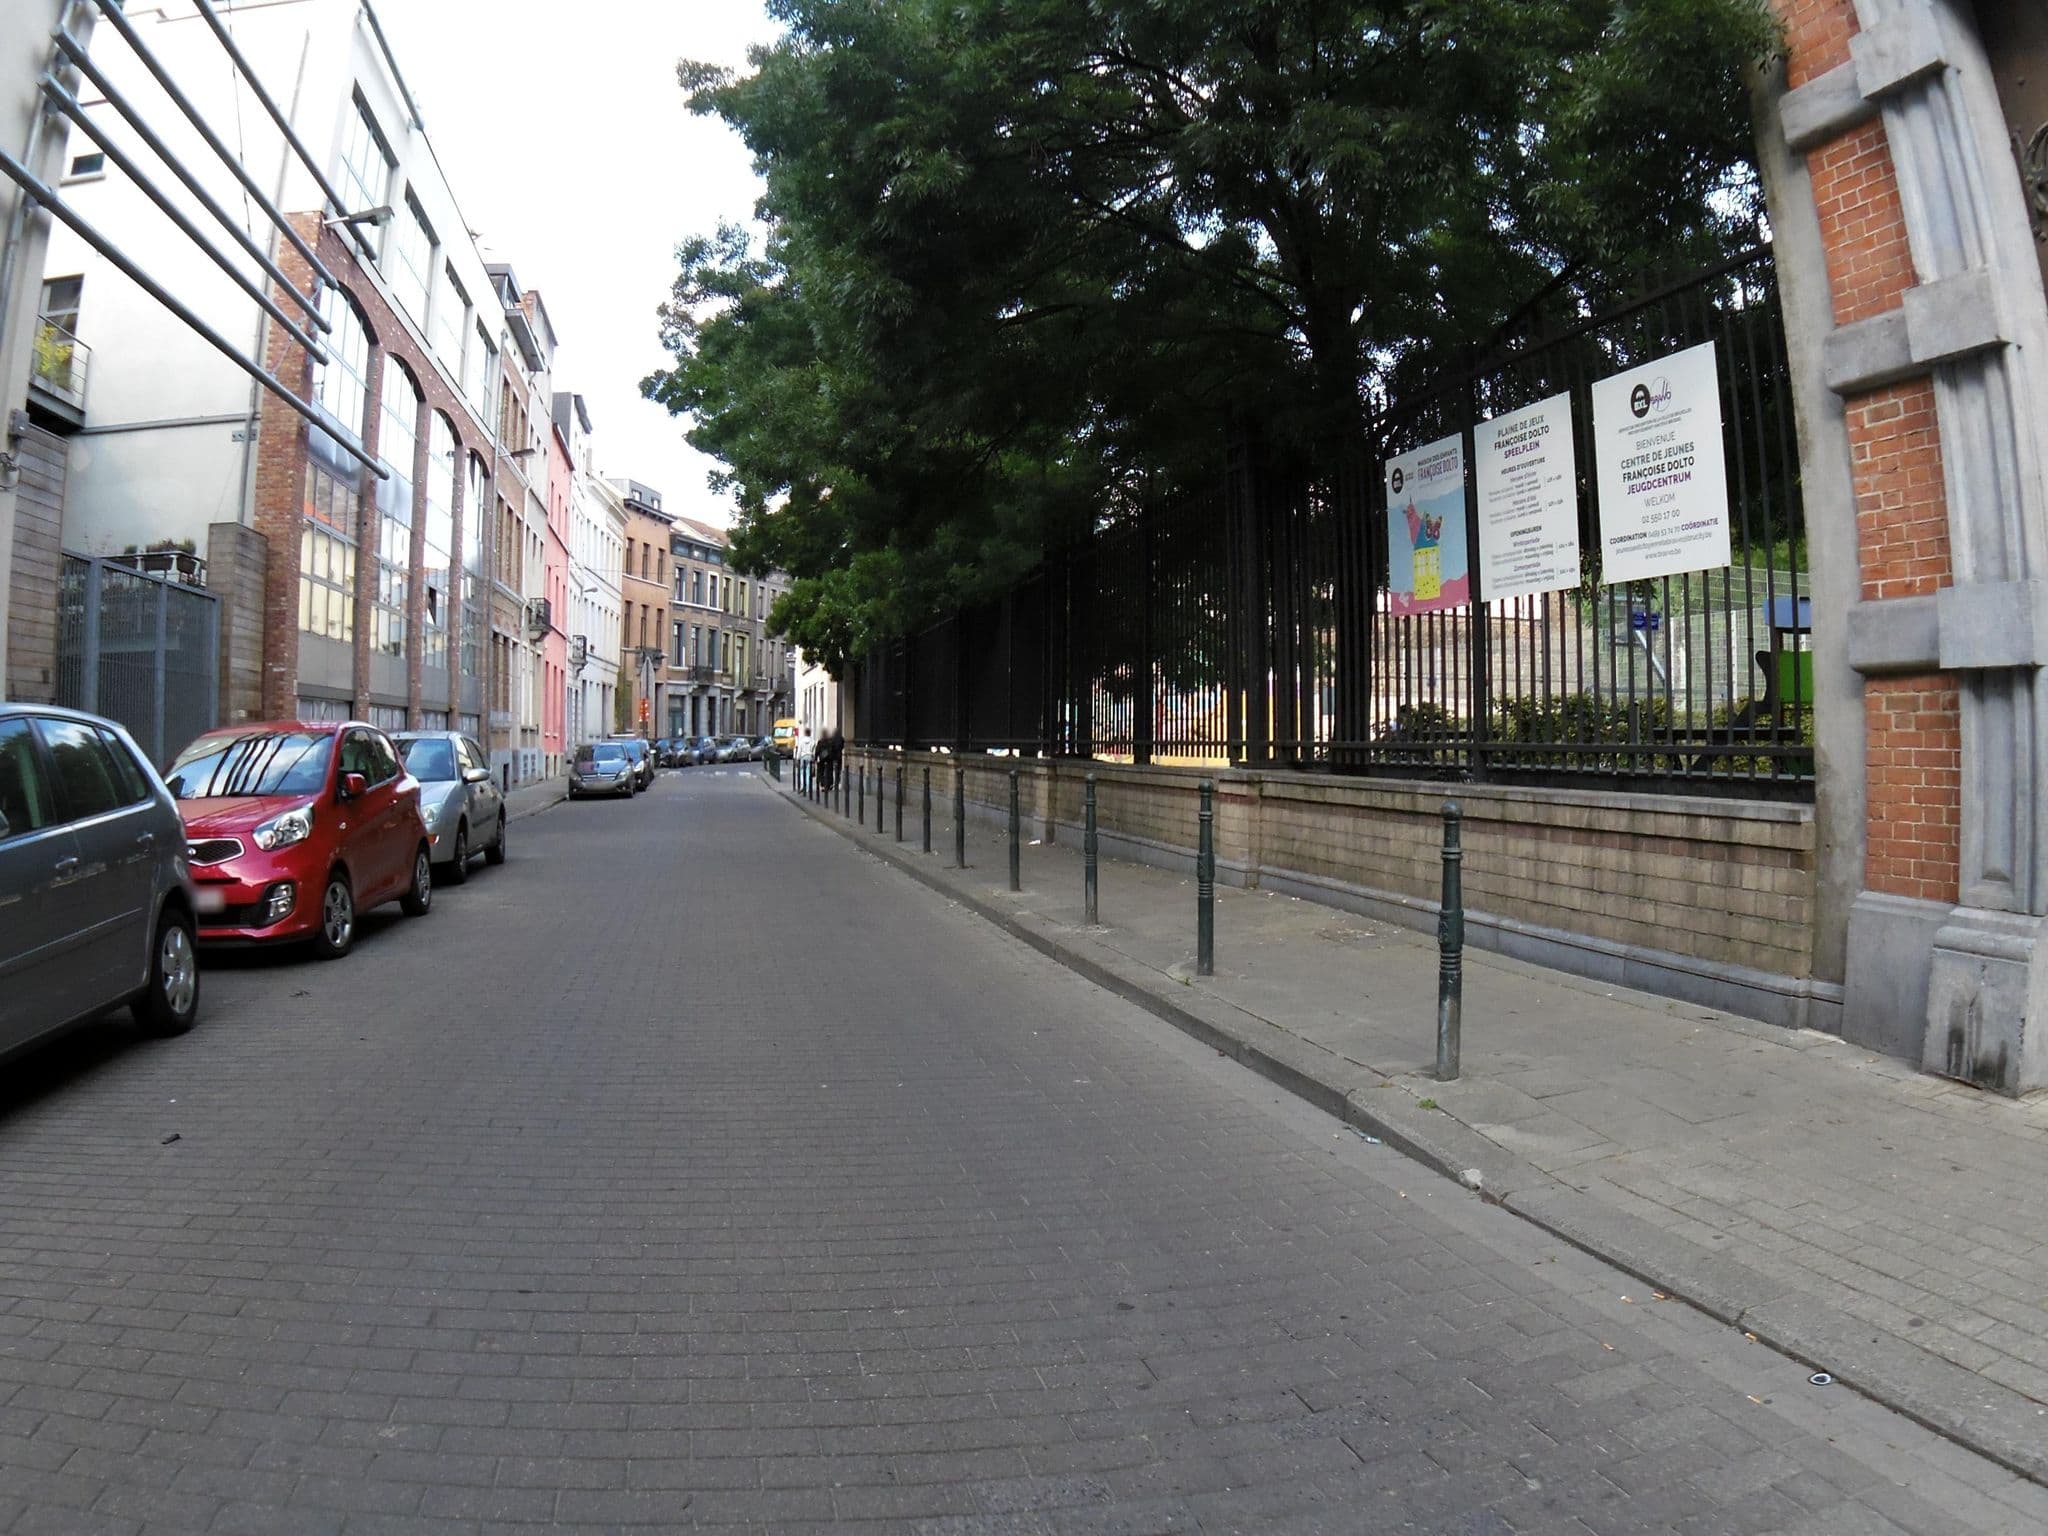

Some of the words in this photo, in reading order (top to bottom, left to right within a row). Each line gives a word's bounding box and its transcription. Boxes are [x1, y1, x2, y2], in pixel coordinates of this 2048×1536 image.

[1494, 432, 1527, 451] FRANÇOISE
[1528, 425, 1550, 438] DOLTO
[1497, 424, 1518, 438] PLAINE
[1520, 420, 1527, 430] DE
[1529, 415, 1545, 427] JEUX
[1504, 440, 1540, 459] SPEELPLEIN
[1636, 431, 1676, 450] BIENVENUE
[1620, 453, 1650, 469] CENTRE
[1652, 450, 1662, 461] DE
[1664, 441, 1694, 459] JEUNES
[1622, 463, 1666, 482] FRANÇOISE
[1667, 456, 1694, 471] DOLTO
[1627, 471, 1691, 495] JEUGDCENTRUM
[1644, 493, 1676, 507] WELKOM
[1609, 531, 1647, 545] COORDINATION
